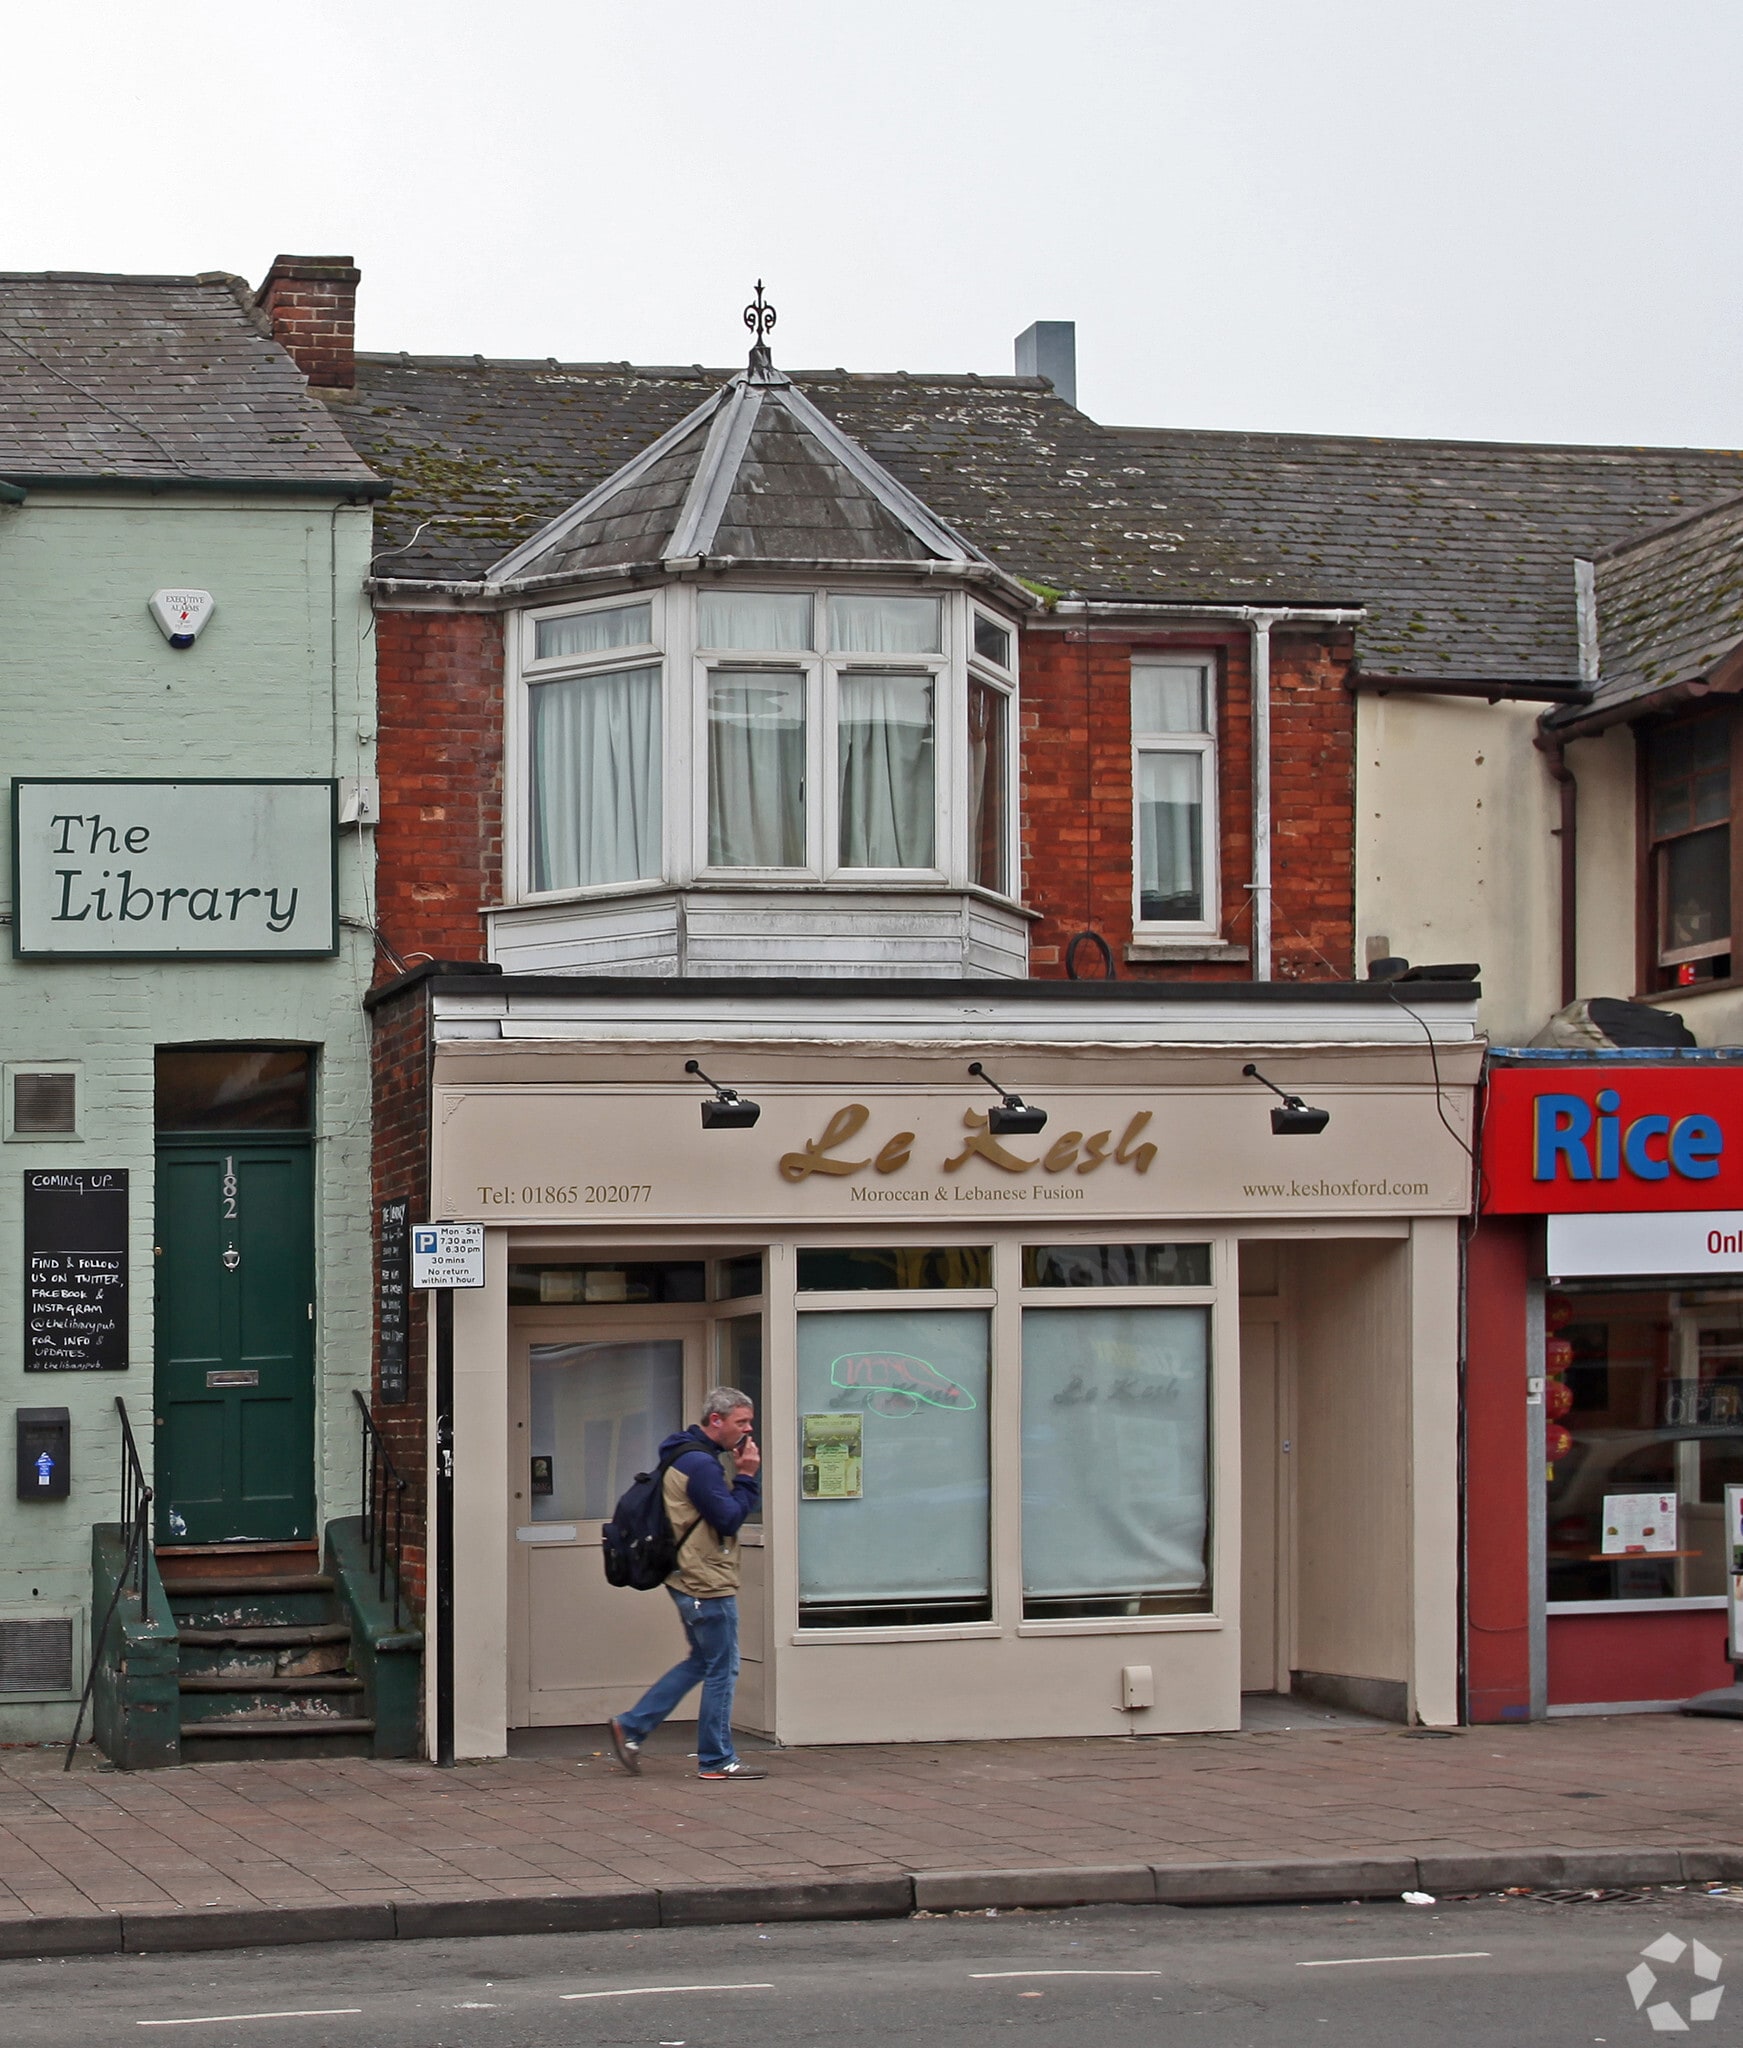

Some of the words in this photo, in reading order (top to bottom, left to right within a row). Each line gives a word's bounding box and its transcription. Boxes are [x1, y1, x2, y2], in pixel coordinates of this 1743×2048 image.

[165, 594, 205, 604] EXECUTIVE
[50, 814, 150, 854] The
[51, 869, 299, 933] Library
[1533, 1088, 1724, 1180] Rice
[780, 1103, 916, 1183] Le
[943, 1106, 1159, 1174] Kesh
[32, 1174, 83, 1196] COMING
[1242, 1179, 1429, 1197] www.keshoxford.com
[477, 1186, 516, 1205] Tel:
[521, 1186, 578, 1205] 01865
[584, 1185, 652, 1203] 202077
[850, 1186, 929, 1201] Moroccan
[934, 1186, 948, 1201] &
[954, 1186, 1027, 1201] Lebanese
[1032, 1185, 1084, 1200] Fusion
[466, 1227, 480, 1235] Sat
[440, 1237, 460, 1245] 7.30
[445, 1245, 466, 1254] 6.30
[467, 1246, 480, 1254] pm
[31, 1257, 59, 1269] FIND
[79, 1259, 119, 1269] FOLLOW
[432, 1256, 444, 1264] 30
[31, 1273, 46, 1283] US
[51, 1273, 67, 1283] ON
[421, 1276, 447, 1284] within
[64, 1336, 90, 1346] INFO
